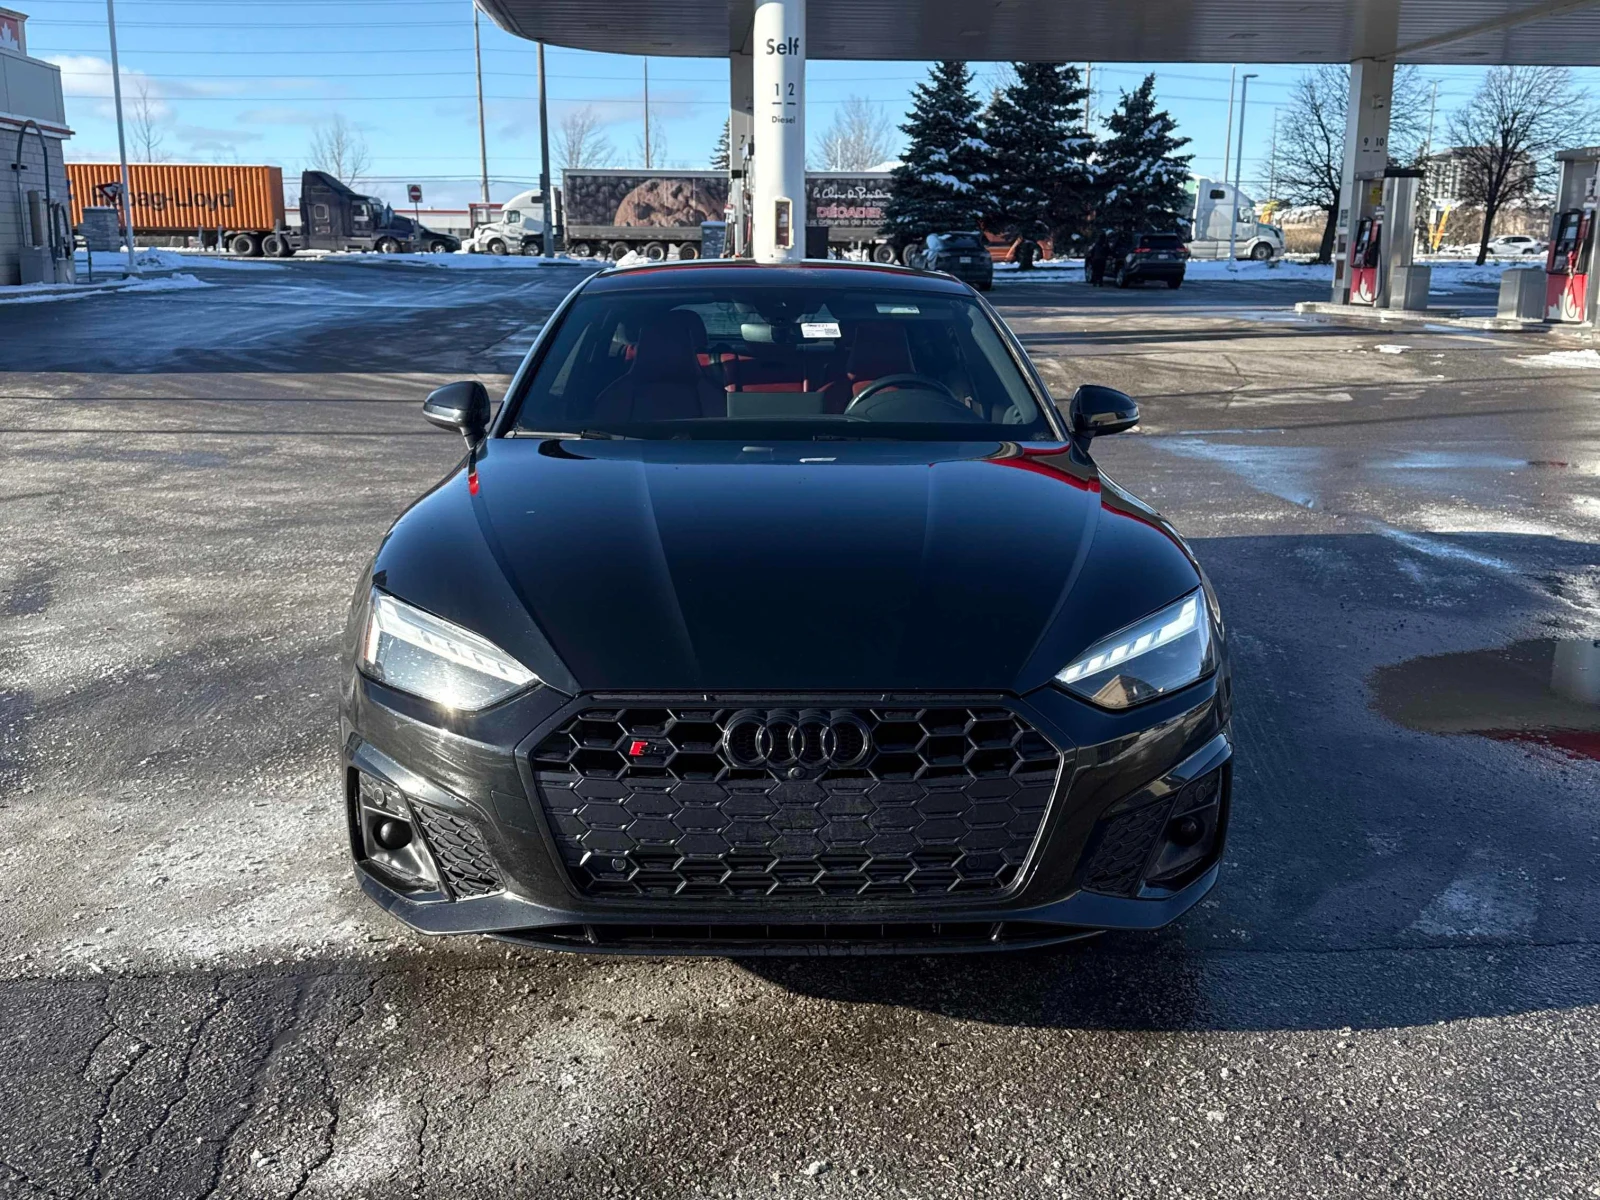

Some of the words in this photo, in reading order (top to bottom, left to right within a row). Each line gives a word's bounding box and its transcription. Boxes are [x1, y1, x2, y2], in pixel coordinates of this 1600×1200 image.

[766, 37, 799, 55] Self
[775, 83, 779, 96] 1
[788, 82, 795, 96] 2
[771, 115, 796, 124] Diesel
[1363, 137, 1369, 146] 9
[1375, 137, 1384, 147] 10
[92, 186, 234, 212] Hpag-Lloyd
